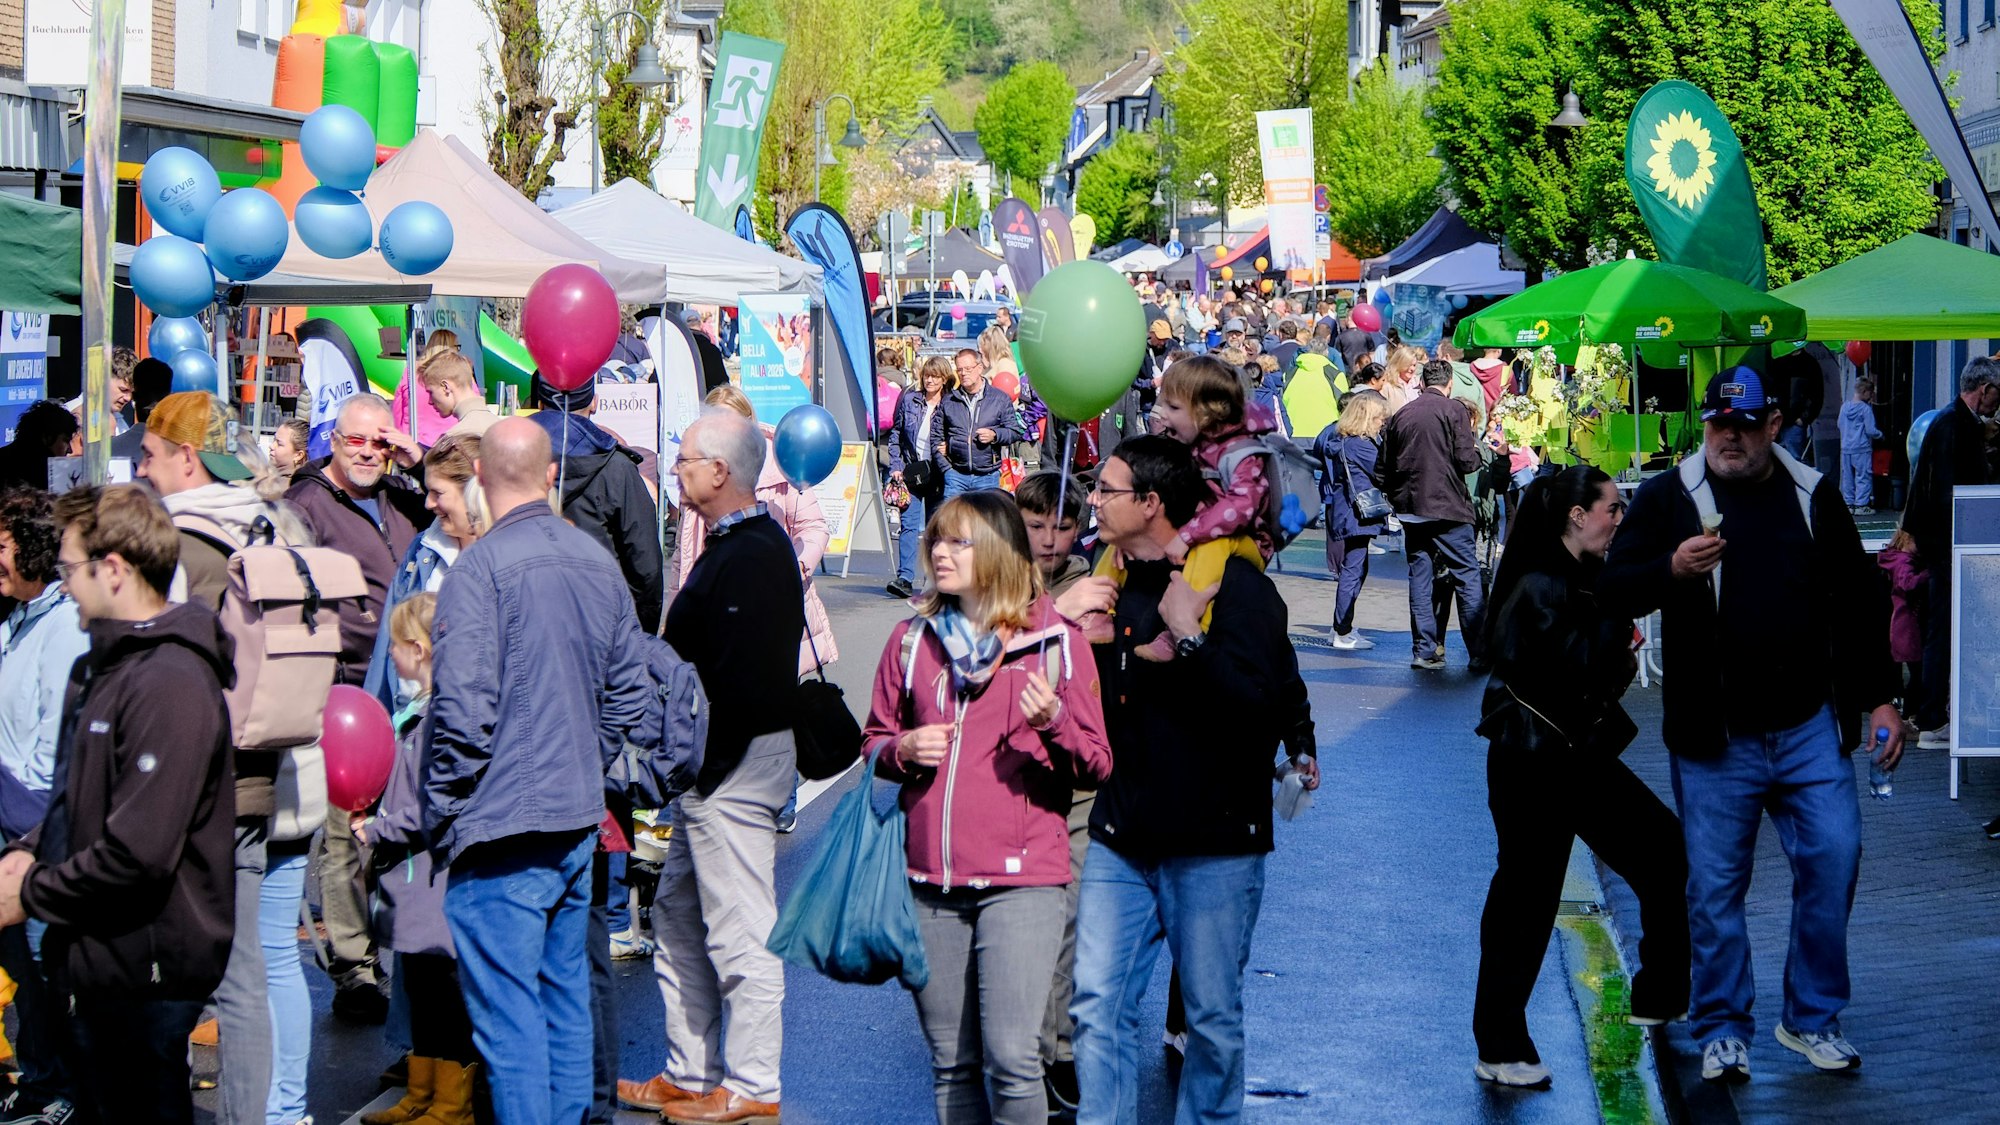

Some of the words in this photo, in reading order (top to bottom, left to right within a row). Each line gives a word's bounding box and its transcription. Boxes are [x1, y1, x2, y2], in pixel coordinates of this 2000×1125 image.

[170, 177, 196, 195] VVIB
[741, 343, 766, 358] BELLA
[767, 363, 785, 378] 2026
[280, 383, 300, 397] 20€
[329, 380, 354, 401] VVIB
[599, 397, 649, 413] BABOR
